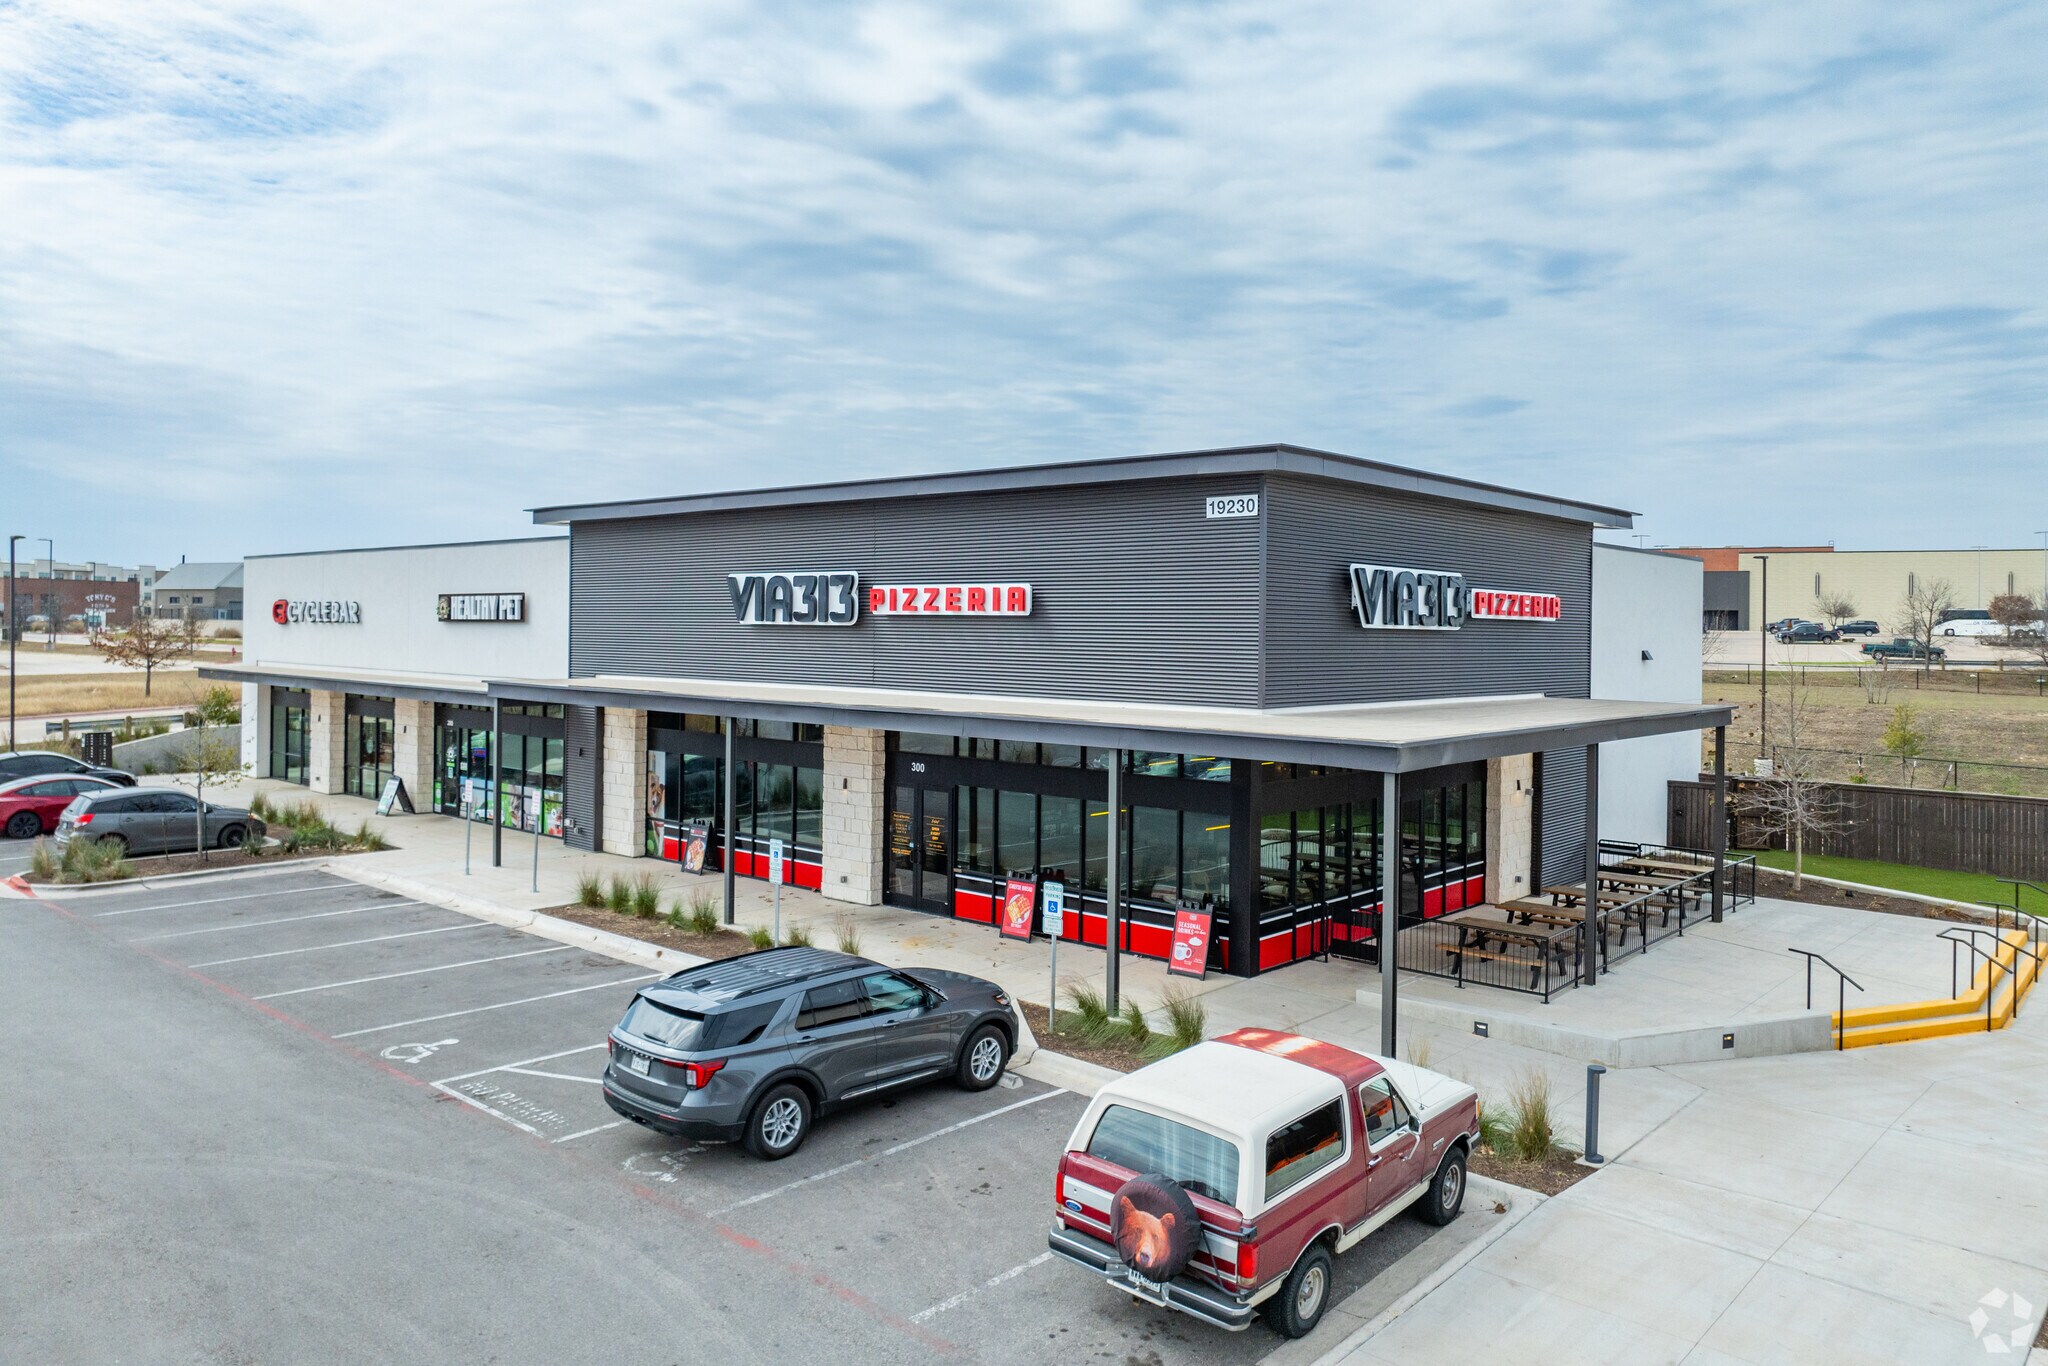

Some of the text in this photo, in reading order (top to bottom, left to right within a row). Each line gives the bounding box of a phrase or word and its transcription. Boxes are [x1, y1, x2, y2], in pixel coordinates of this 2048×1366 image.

[1209, 498, 1256, 515] 19230
[450, 595, 523, 620] HEALTHY PET
[870, 586, 1025, 612] PIZZERIA
[1475, 591, 1560, 619] PIZZERIA
[287, 600, 361, 624] CYCLEBAR
[911, 762, 925, 773] 300
[1178, 921, 1201, 931] SEASONAL
